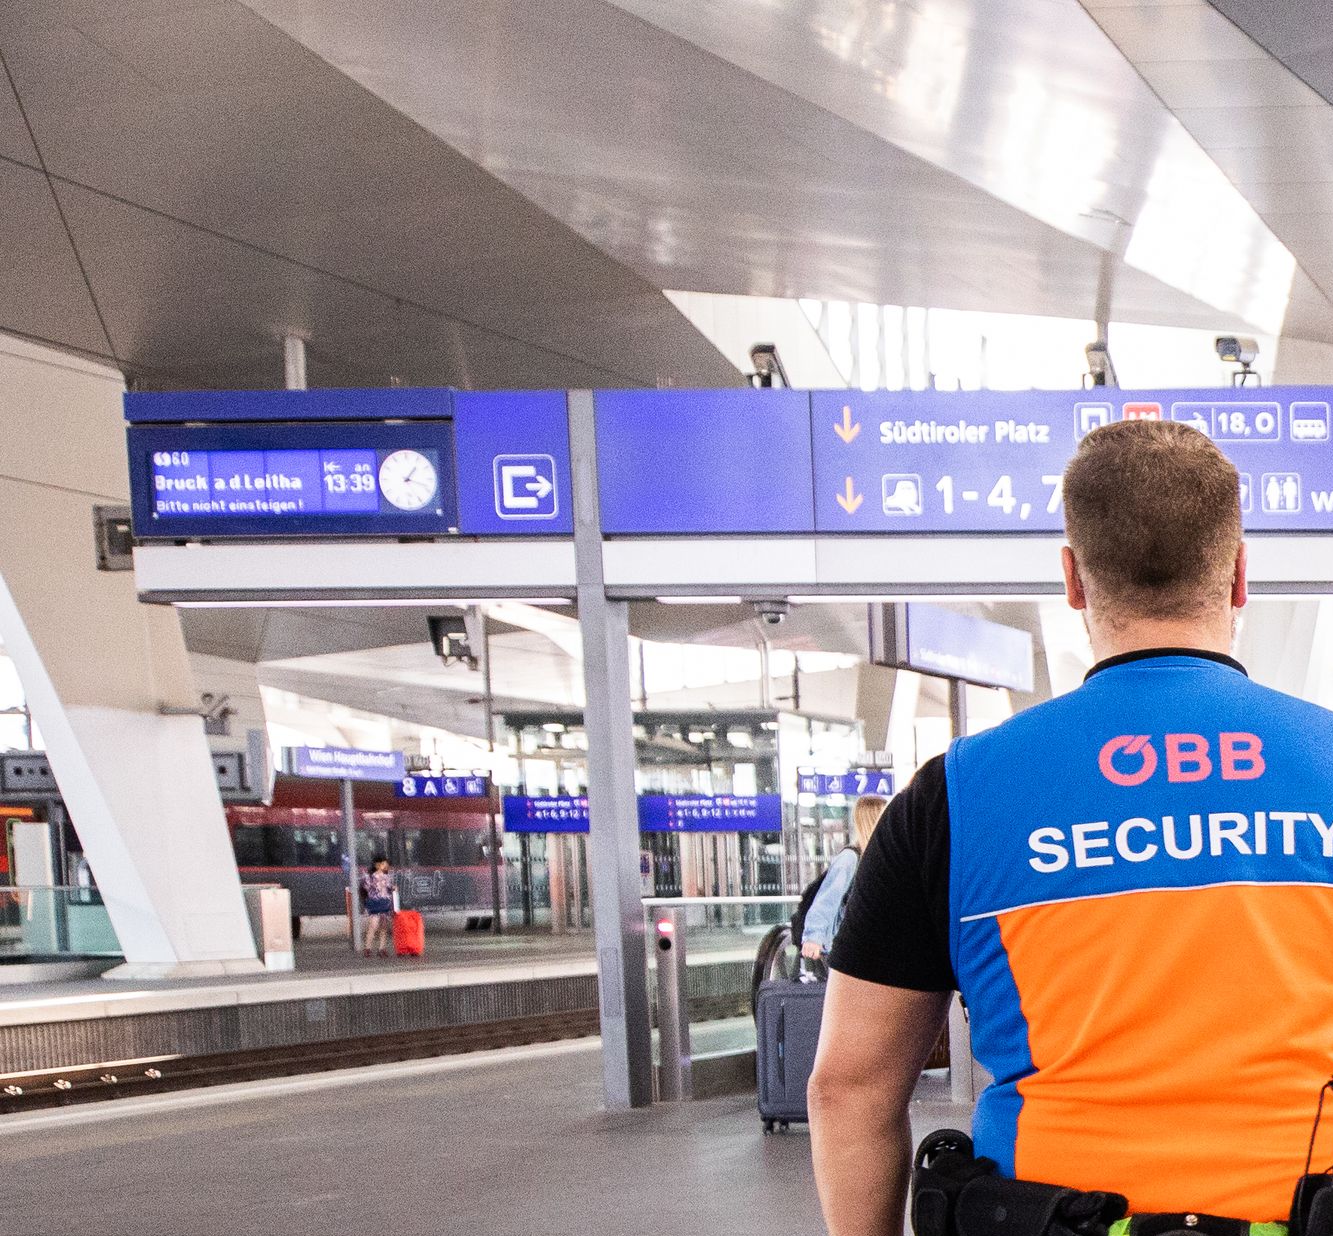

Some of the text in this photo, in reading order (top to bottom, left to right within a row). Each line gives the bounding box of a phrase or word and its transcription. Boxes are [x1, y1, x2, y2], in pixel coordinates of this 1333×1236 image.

[879, 419, 1050, 445] Südtiroler Platz
[155, 474, 208, 491] Bruck
[324, 474, 376, 492] 13:39
[156, 500, 189, 513] Bitte
[192, 499, 226, 512] nicht
[1098, 732, 1266, 786] ÖBB
[402, 777, 437, 797] 8 A
[876, 778, 890, 794] A
